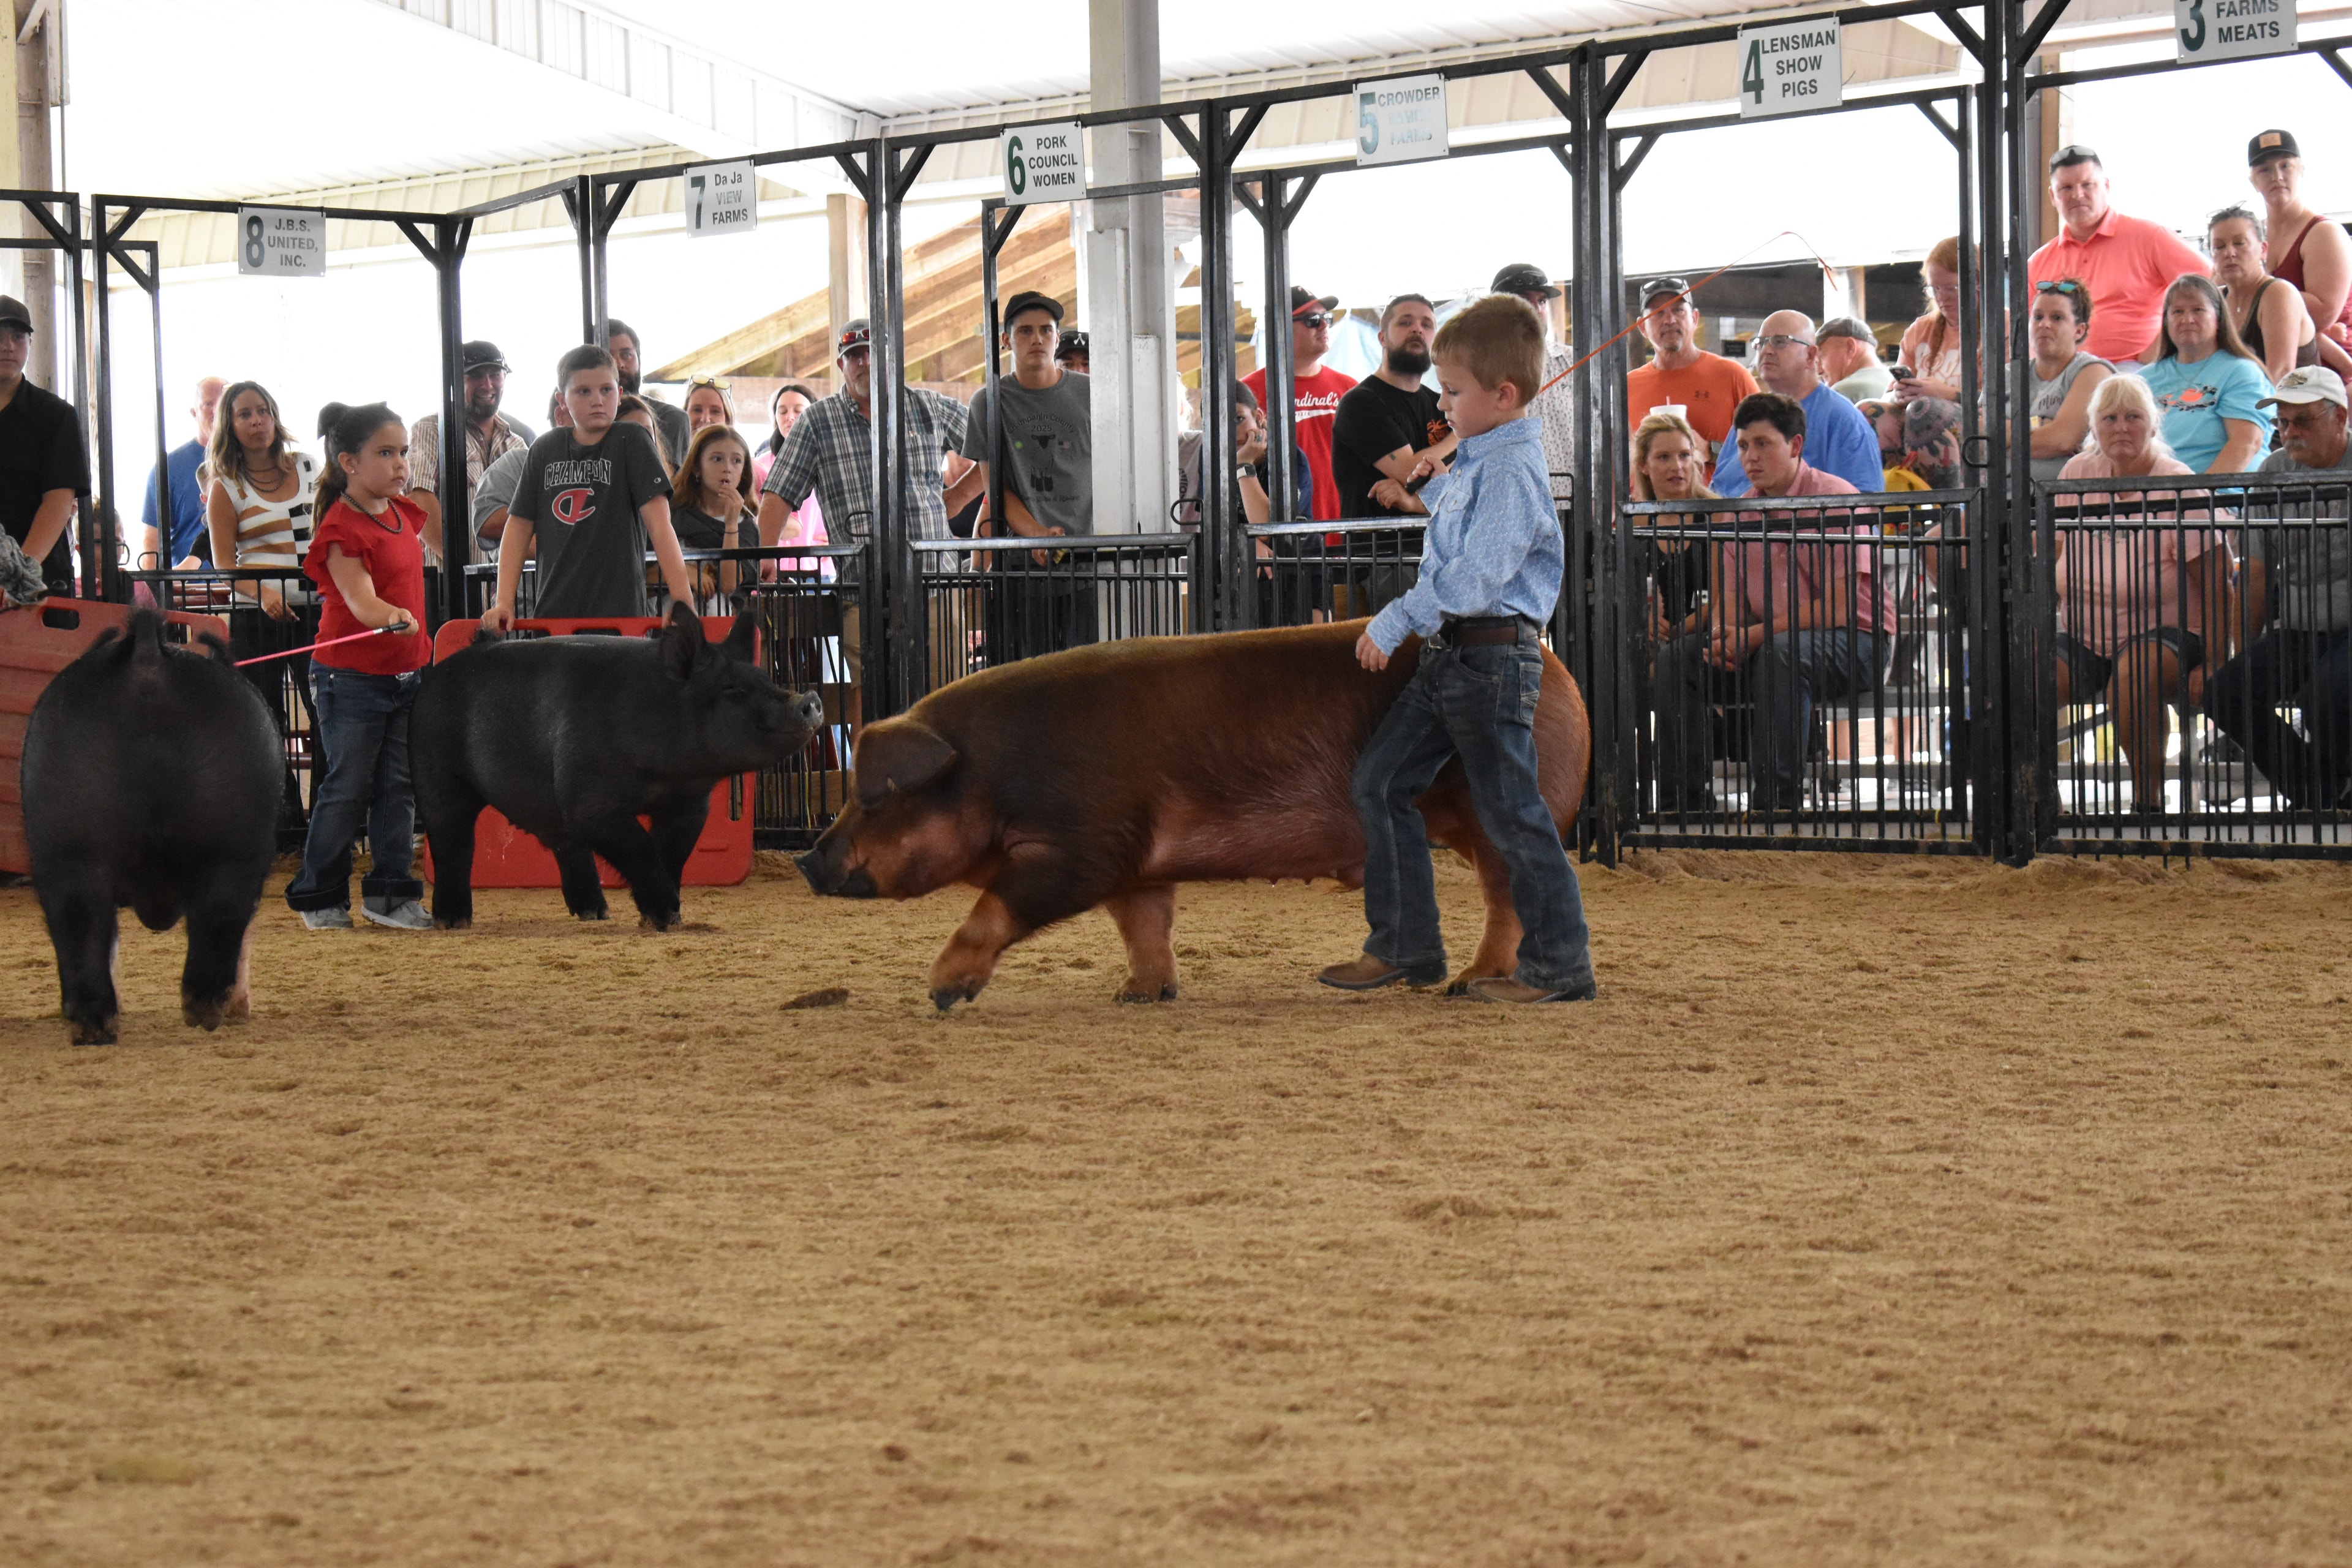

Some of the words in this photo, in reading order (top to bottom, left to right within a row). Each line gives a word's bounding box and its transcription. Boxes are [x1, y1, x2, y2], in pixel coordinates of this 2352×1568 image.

[2216, 0, 2279, 18] FARMS
[2180, 0, 2206, 52] 3
[2218, 21, 2280, 43] MEATS
[1762, 29, 1836, 54] LENSMAN
[1743, 39, 1765, 104] 4
[1776, 55, 1822, 75] SHOW
[1378, 86, 1440, 107] CROWDER
[1782, 78, 1818, 98] PIGS
[1360, 92, 1379, 154] 5
[1036, 135, 1067, 150] PORK
[1390, 127, 1433, 145] FARMS
[1008, 135, 1026, 195] 6
[1029, 153, 1078, 169] COUNCIL
[714, 173, 728, 186] Da
[731, 171, 742, 184] Ja
[1033, 172, 1076, 187] WOMEN
[690, 175, 706, 229] 7
[715, 189, 742, 205] VIEW
[275, 218, 311, 232] J.B.S.
[712, 208, 748, 225] FARMS
[246, 215, 265, 268] 8
[268, 236, 318, 252] UNITED,
[280, 254, 306, 267] INC.
[1294, 391, 1339, 407] rdinal's
[545, 458, 611, 490] CHAMPON
